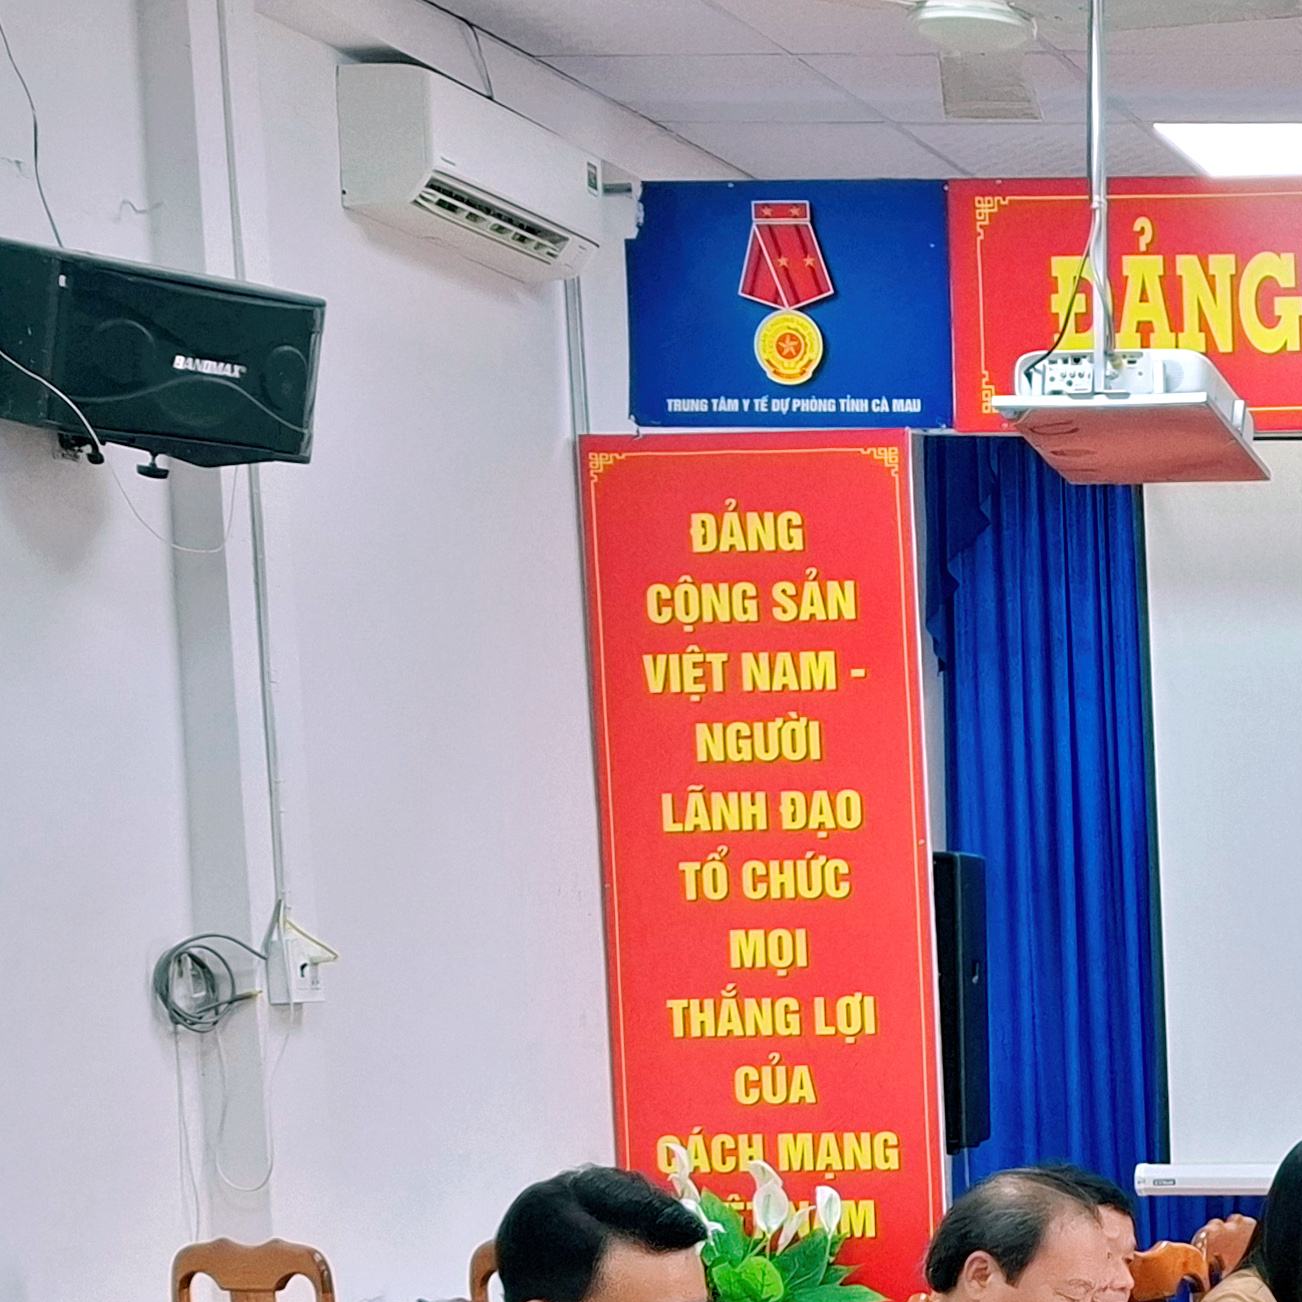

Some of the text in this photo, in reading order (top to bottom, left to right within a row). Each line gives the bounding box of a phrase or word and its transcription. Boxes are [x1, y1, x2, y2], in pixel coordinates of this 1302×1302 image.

[667, 395, 922, 415] TRUNG TÂM Y TẾ DỰ PHÒNG TỈNH CÀ MAU
[690, 499, 803, 552] ĐẢNG
[647, 568, 855, 631] CỘNG SẢN
[643, 645, 865, 701] VIỆT NAM -
[696, 712, 820, 761] NGƯỜI
[662, 785, 861, 838] LÃNH ĐẠO
[679, 846, 849, 900] TỔ CHỨC
[730, 929, 807, 976] MỌI
[667, 984, 875, 1043] THẮNG LỢI
[735, 1053, 816, 1104] CỦA
[656, 1126, 900, 1180] CÁCH MẠNG
